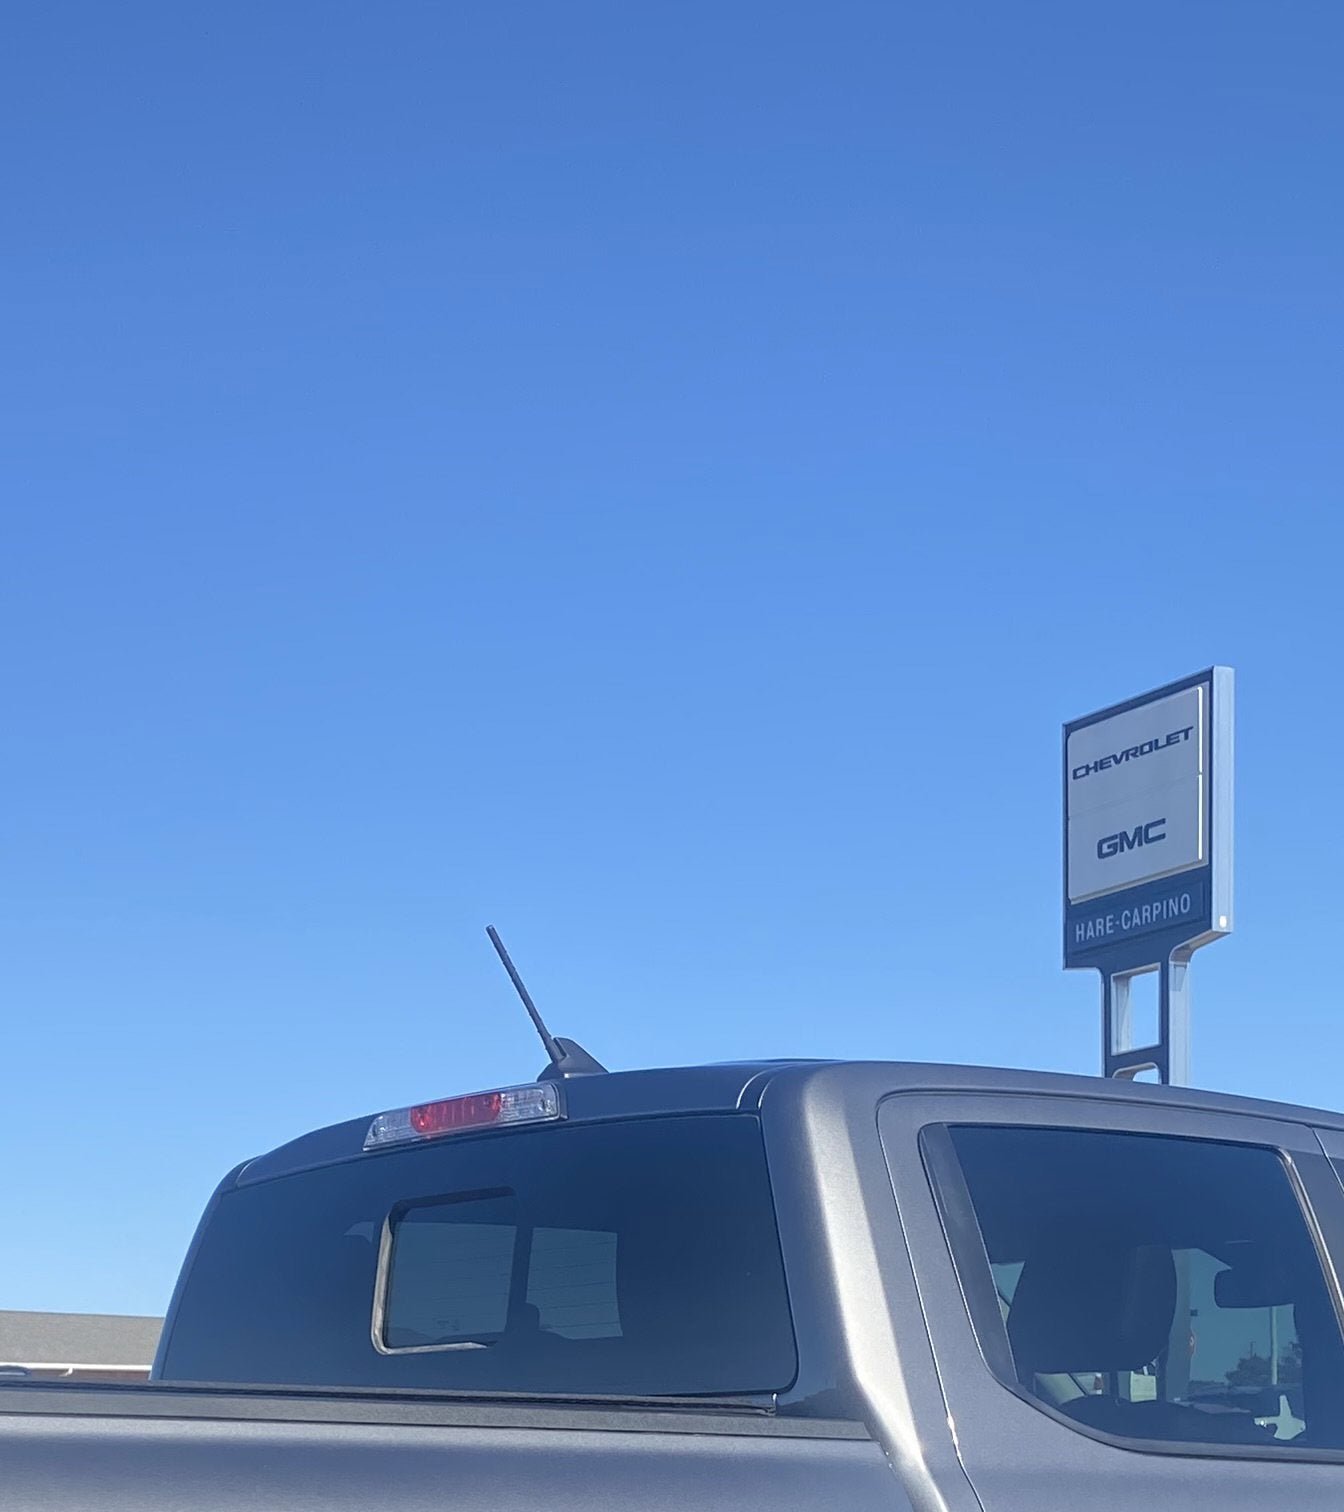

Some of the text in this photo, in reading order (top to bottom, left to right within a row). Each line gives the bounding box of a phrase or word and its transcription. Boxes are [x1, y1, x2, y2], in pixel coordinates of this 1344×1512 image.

[1072, 726, 1194, 781] CHEVROLET
[1097, 818, 1167, 860] GMC
[1076, 893, 1192, 944] HARE-CARPINO
